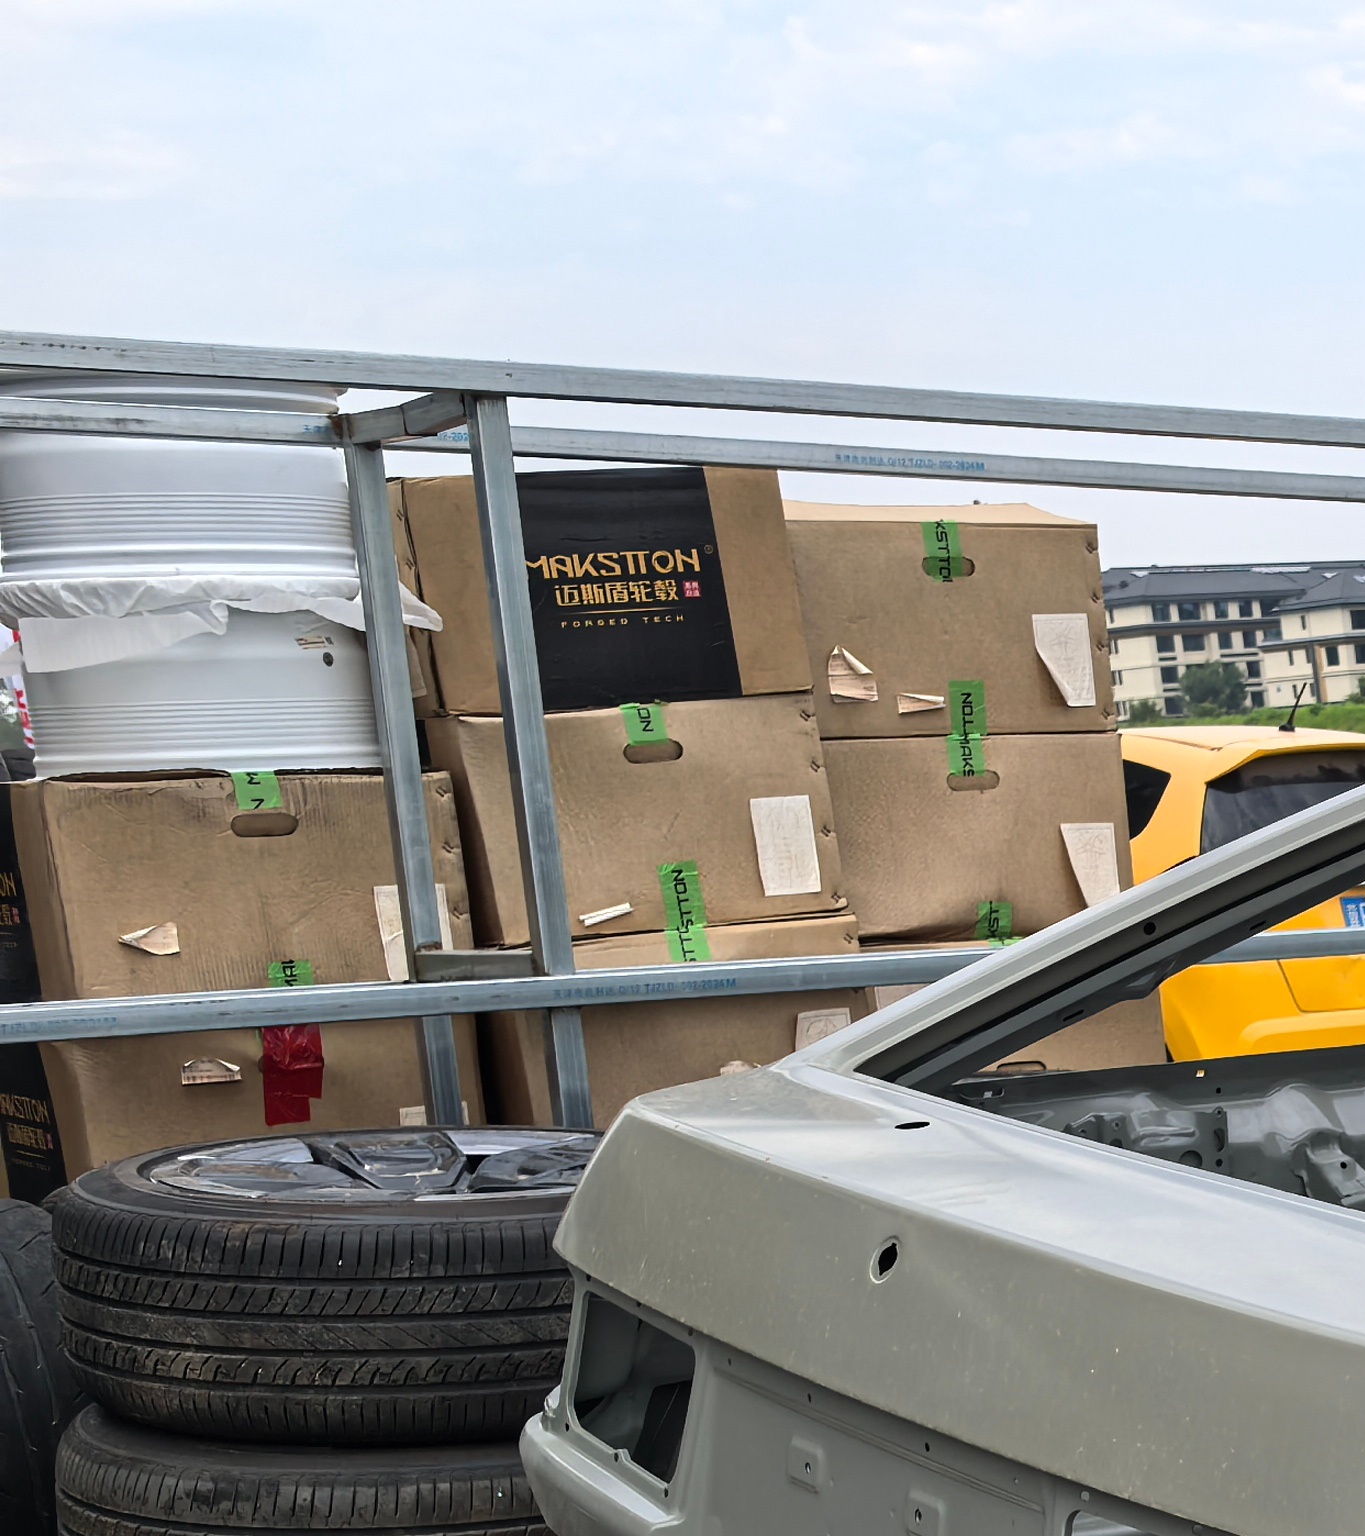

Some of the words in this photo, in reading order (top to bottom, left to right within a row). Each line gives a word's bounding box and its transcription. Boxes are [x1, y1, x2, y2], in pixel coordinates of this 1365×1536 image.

[553, 579, 680, 607] 迈斯盾轮毂
[560, 617, 630, 629] FORGED
[642, 614, 685, 624] TECH
